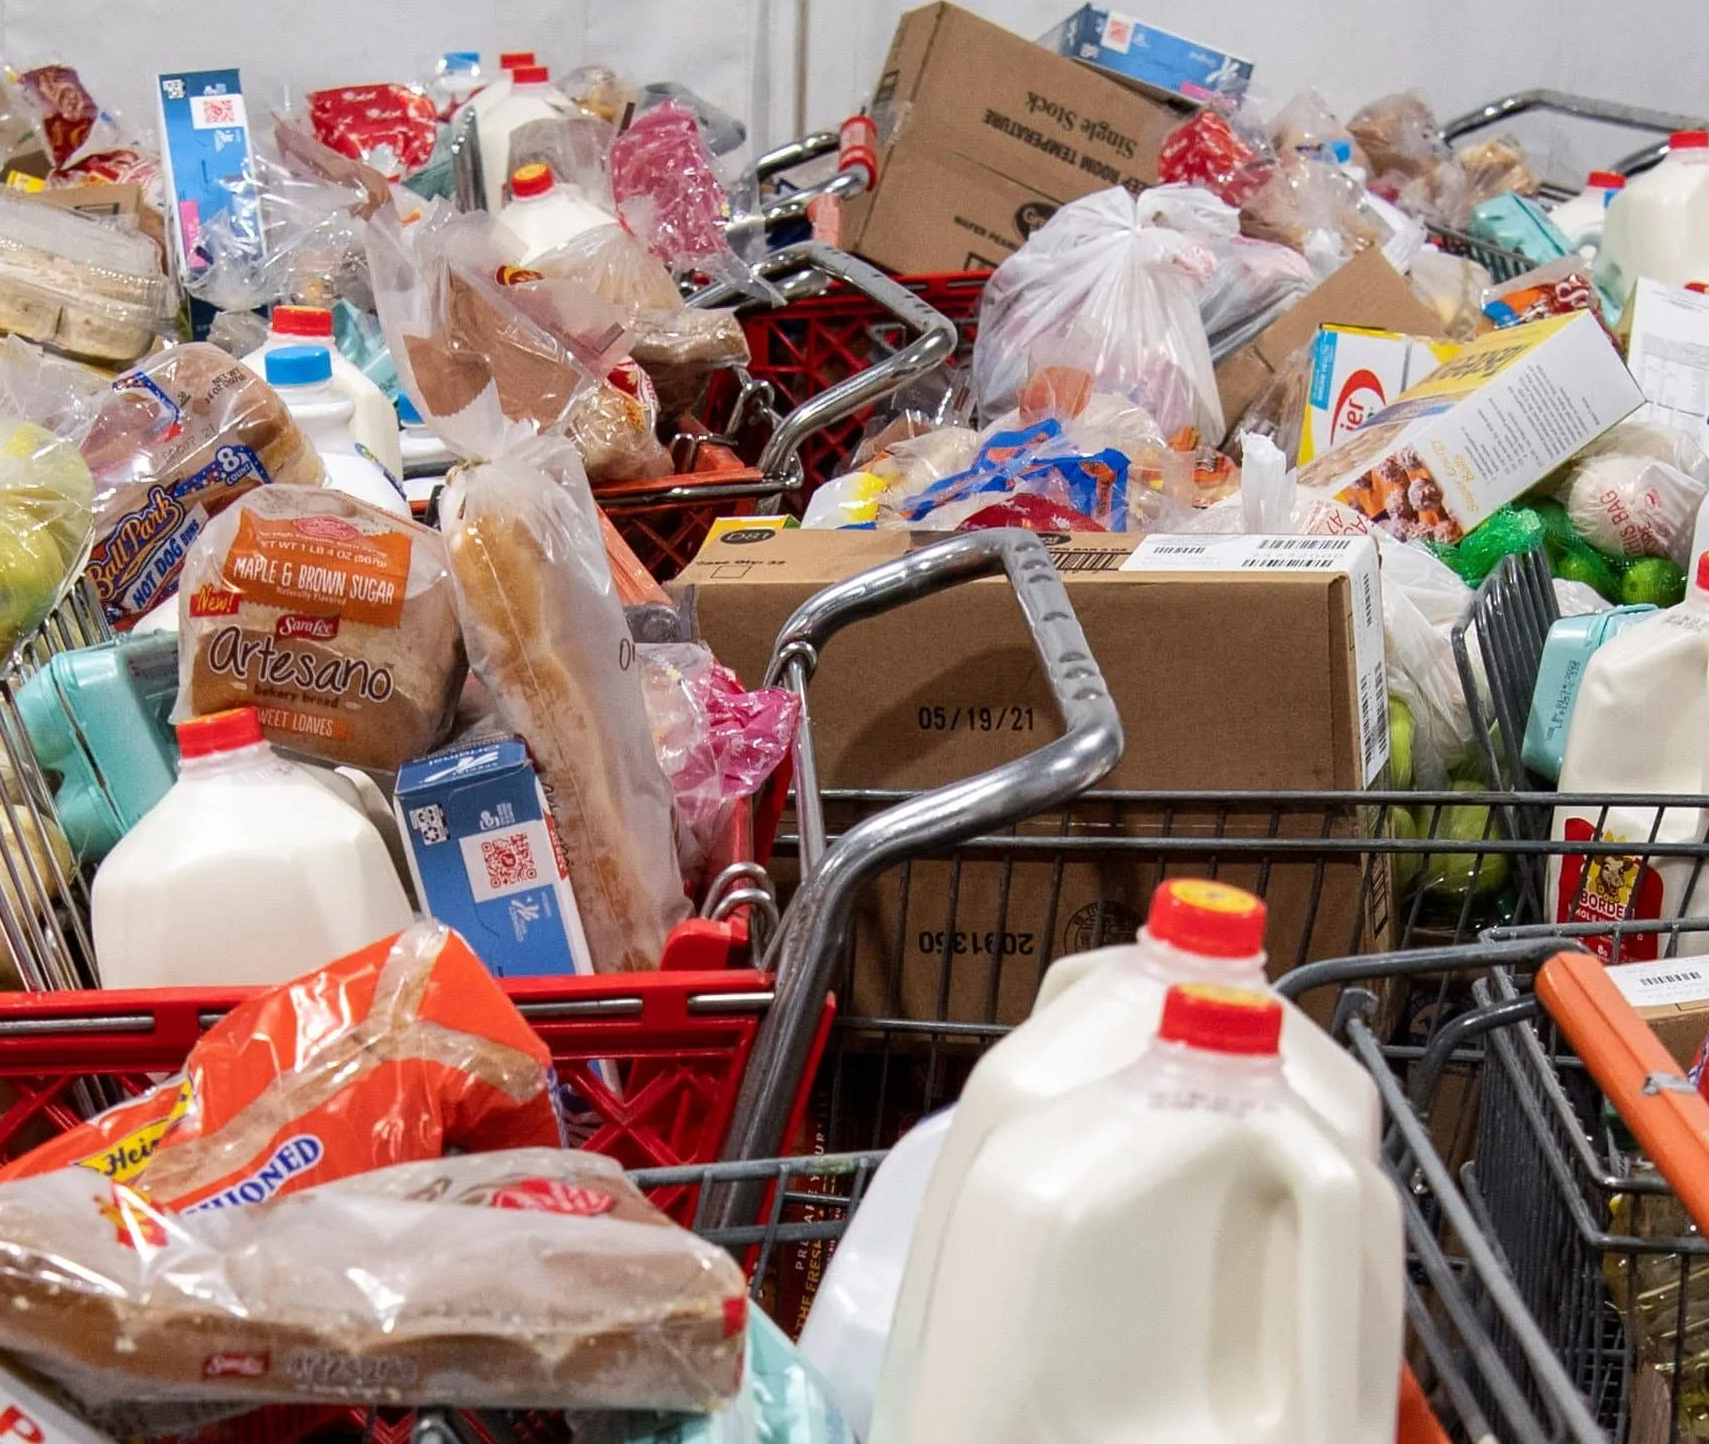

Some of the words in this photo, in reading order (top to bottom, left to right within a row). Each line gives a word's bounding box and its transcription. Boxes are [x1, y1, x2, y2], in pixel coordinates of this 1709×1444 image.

[1026, 91, 1078, 130] Stock
[982, 108, 1078, 168] TEMPERATURE
[1080, 116, 1138, 160] Single
[1078, 154, 1121, 184] ROOM
[217, 446, 241, 471] 8
[225, 462, 253, 486] COUNT
[1599, 488, 1630, 524] BAG
[87, 531, 130, 599] Ball
[121, 486, 180, 552] Park
[279, 541, 297, 551] WT
[308, 544, 325, 555] LB
[336, 549, 353, 561] OZ
[132, 566, 162, 609] HOT
[155, 539, 184, 577] DOG
[234, 557, 278, 585] MAPLE
[281, 563, 294, 587] &
[297, 564, 348, 597] BROWN
[349, 575, 396, 606] SUGAR
[196, 583, 235, 613] New!
[279, 616, 311, 637] Sara
[309, 618, 335, 637] Lee
[253, 682, 300, 701] bakery
[302, 692, 340, 710] bread
[257, 707, 290, 727] WEET
[292, 712, 334, 737] LOAVES
[917, 706, 1035, 732] 05/19/21
[428, 744, 501, 766] Original
[1578, 889, 1626, 921] BORDE
